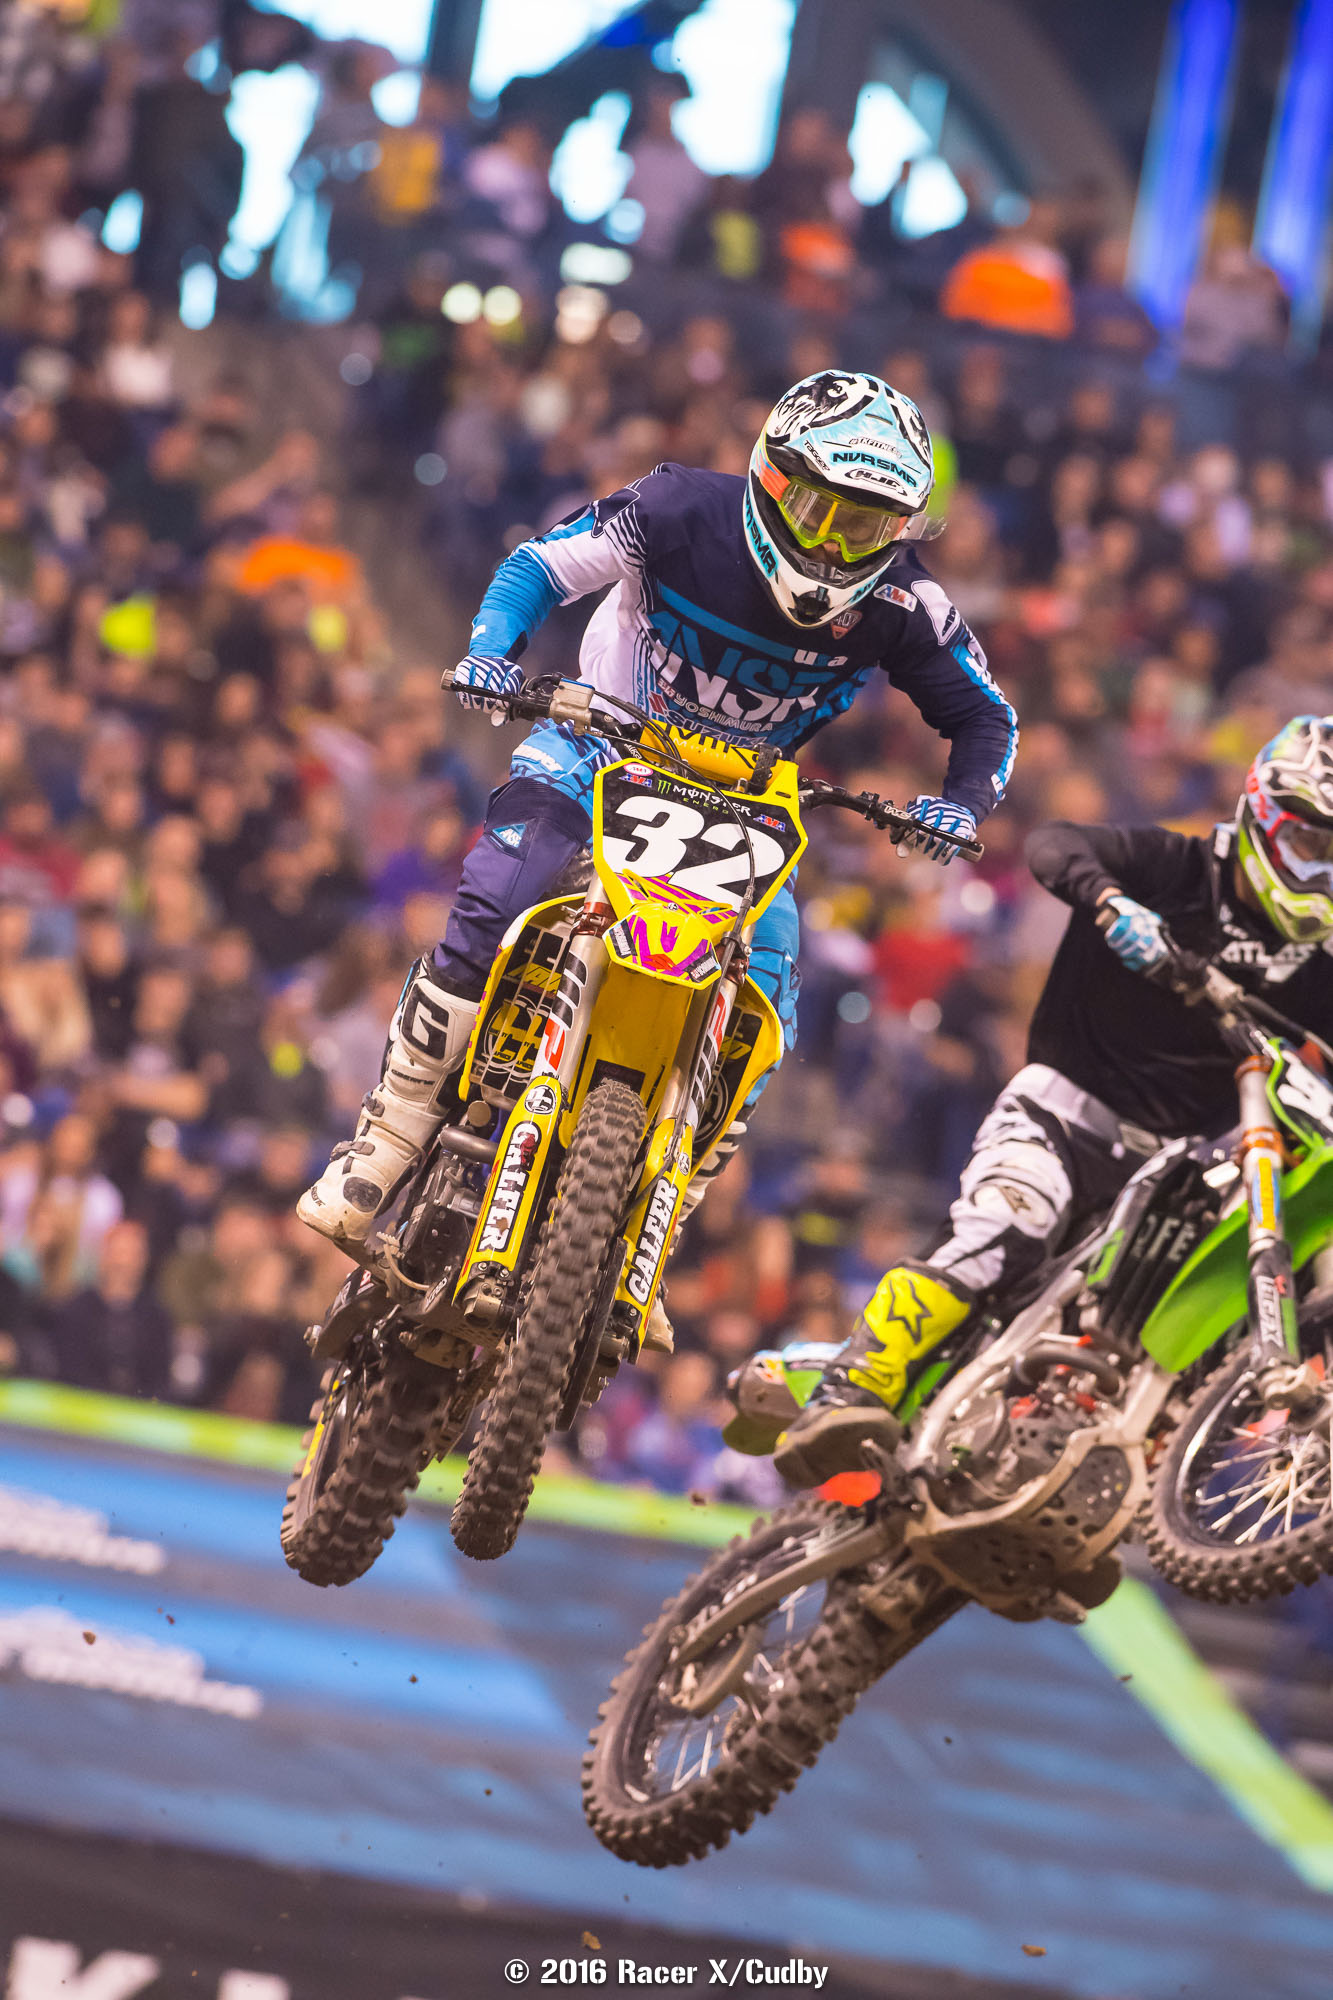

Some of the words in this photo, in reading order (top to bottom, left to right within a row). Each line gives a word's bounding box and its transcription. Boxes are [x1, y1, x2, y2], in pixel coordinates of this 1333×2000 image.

[674, 694, 773, 732] YOSHIMURA
[618, 773, 653, 788] AMA
[683, 797, 729, 815] ENERG
[753, 813, 786, 832] AMA
[603, 795, 786, 914] 32
[478, 1123, 541, 1252] GALFER
[628, 1178, 679, 1303] GALFER
